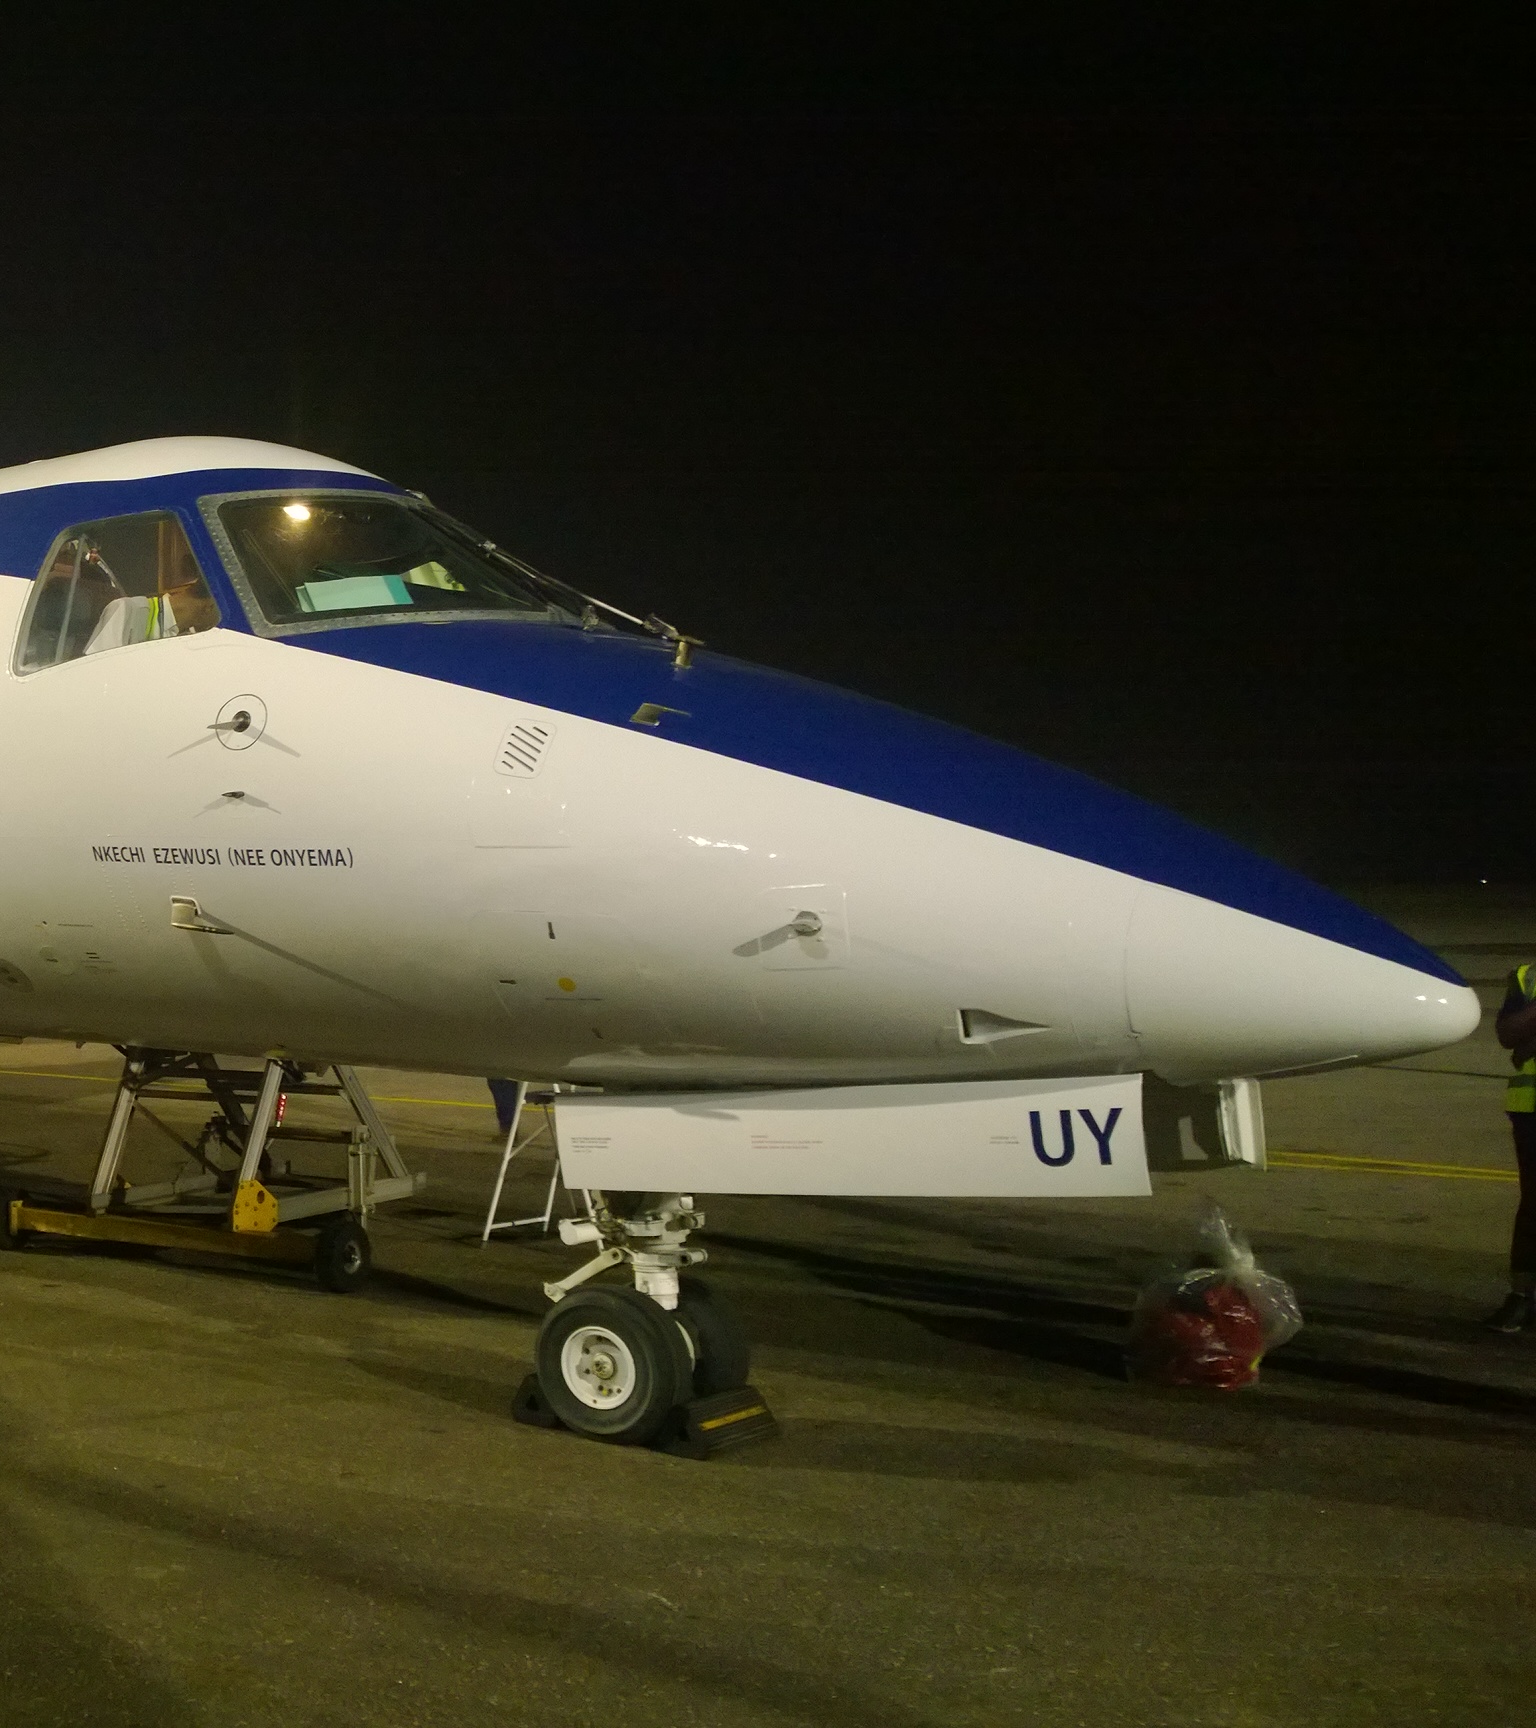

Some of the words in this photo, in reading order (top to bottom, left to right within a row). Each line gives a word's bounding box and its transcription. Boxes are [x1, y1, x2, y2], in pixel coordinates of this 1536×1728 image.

[92, 845, 146, 863] NKECHI
[153, 847, 221, 865] EZEWUSI
[227, 847, 266, 867] (NEE
[271, 848, 354, 868] ONYEMA)
[1029, 1108, 1123, 1167] UY
